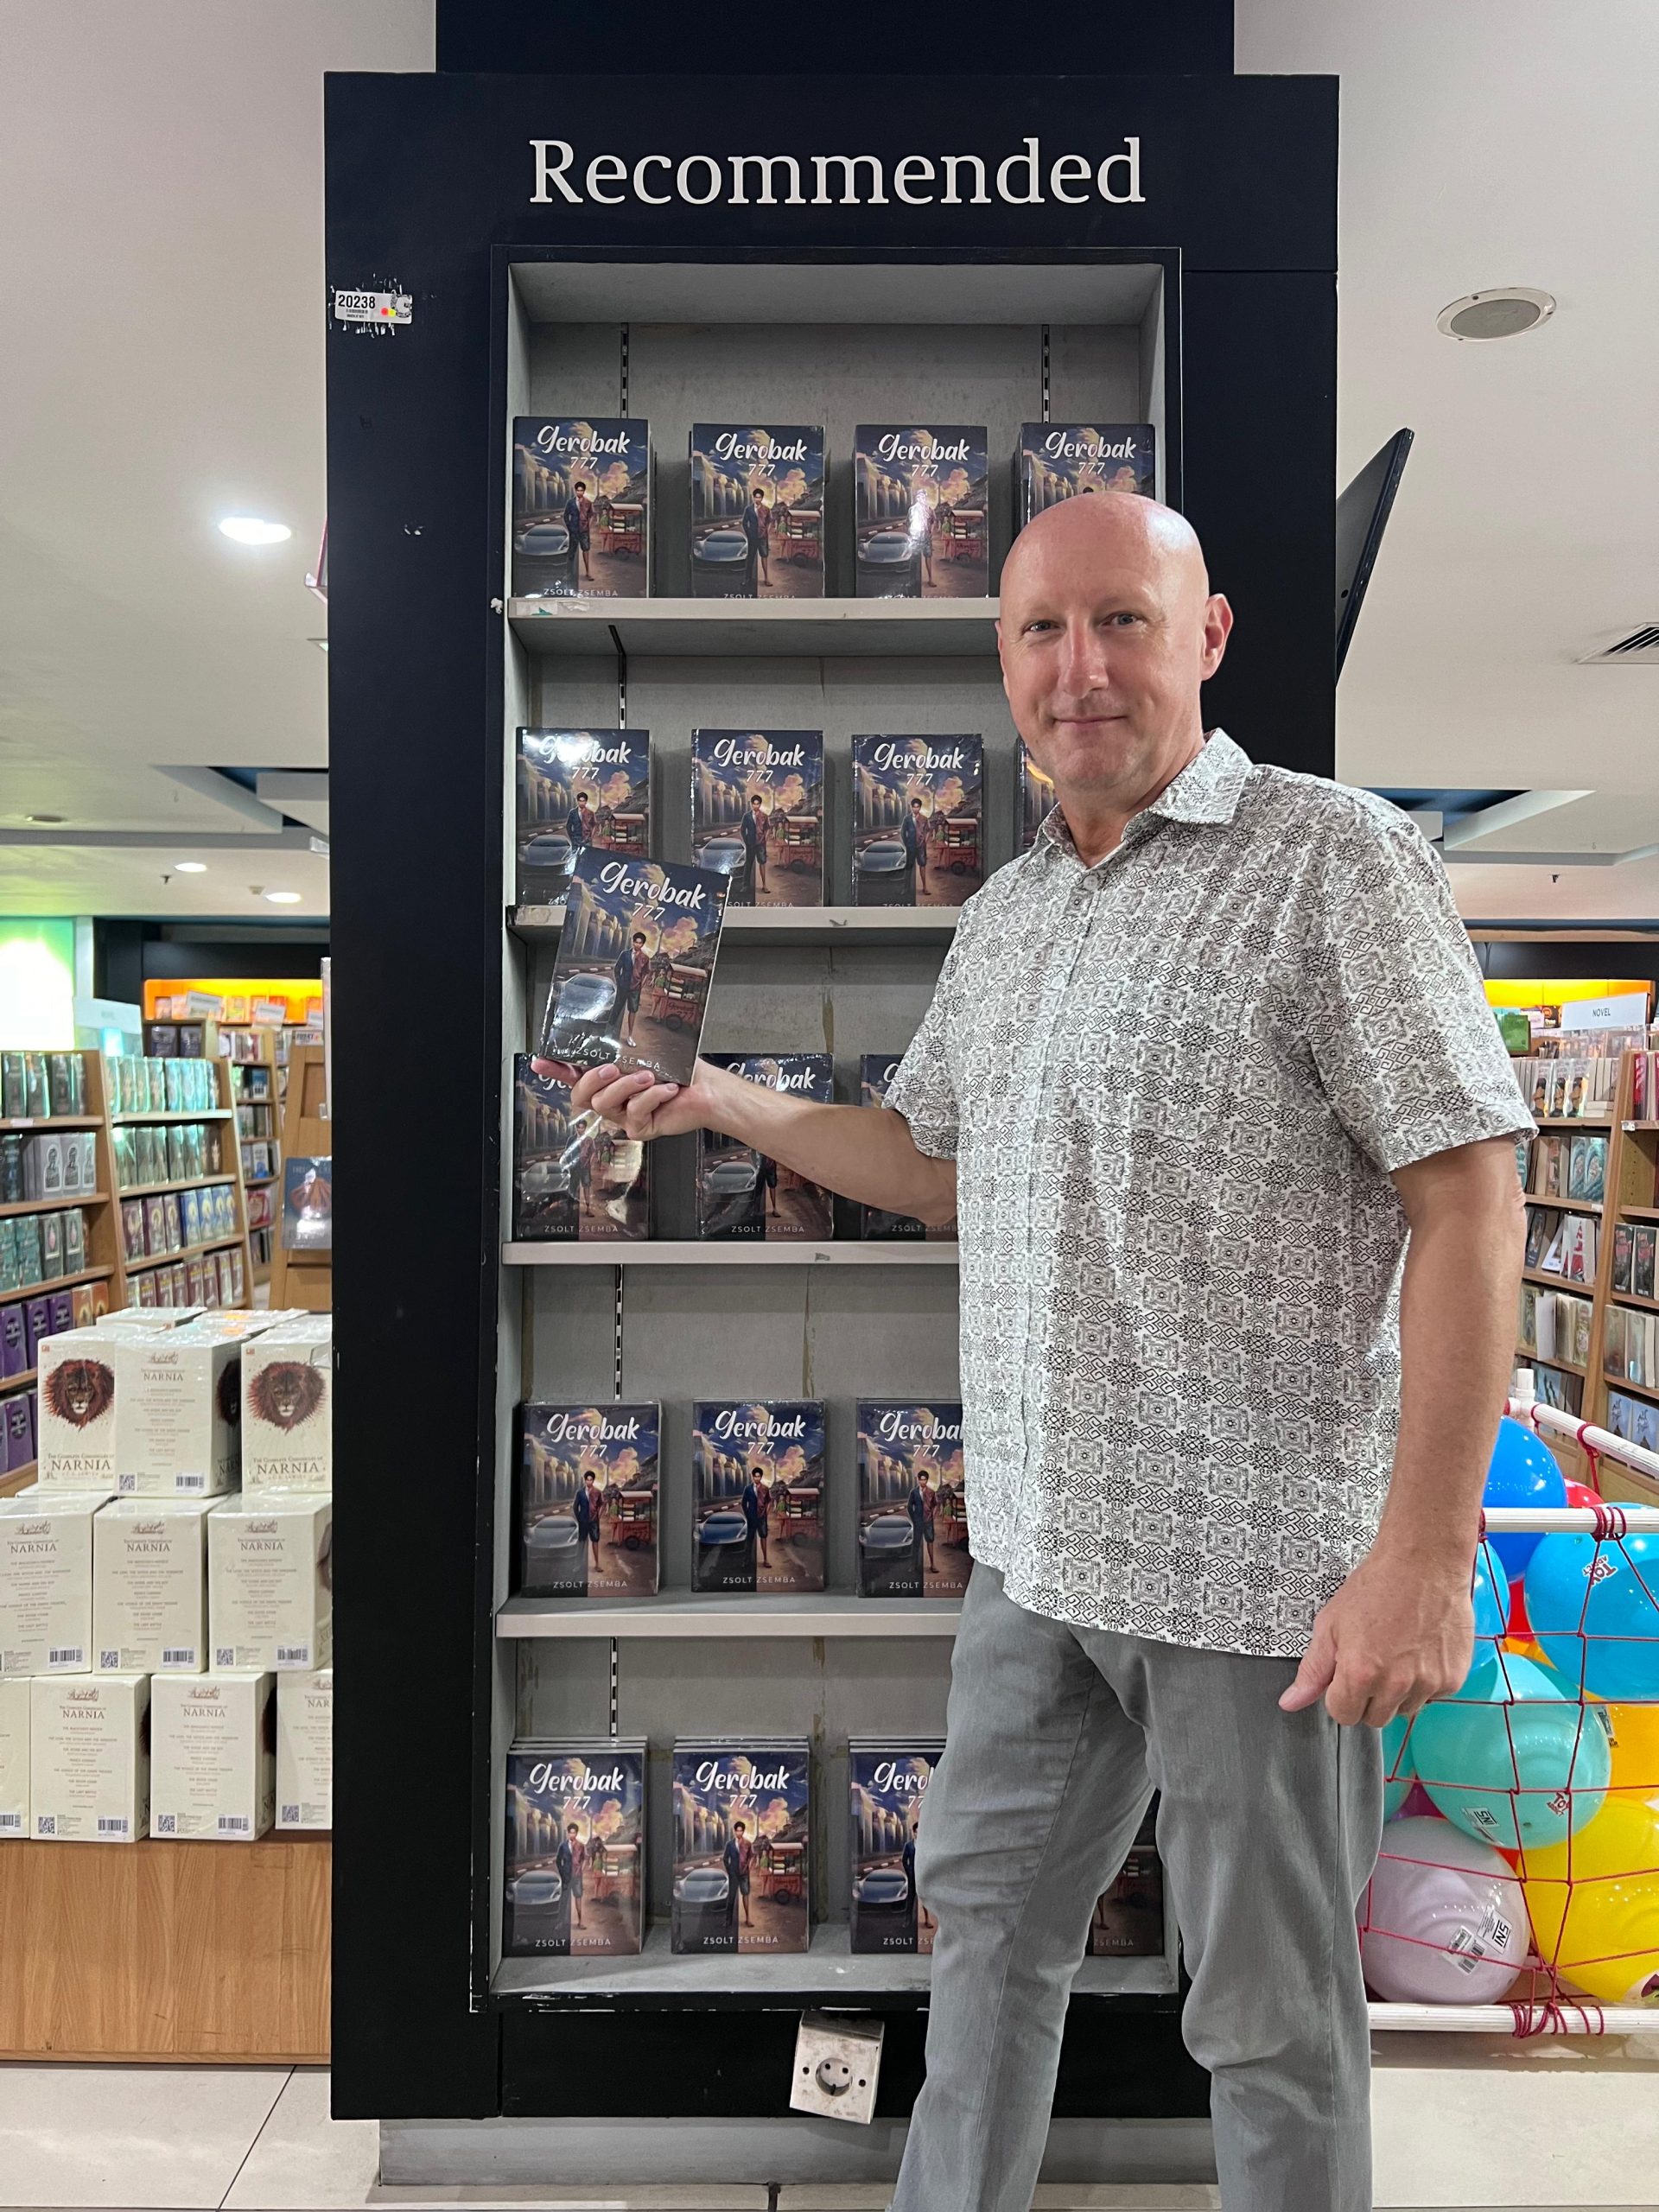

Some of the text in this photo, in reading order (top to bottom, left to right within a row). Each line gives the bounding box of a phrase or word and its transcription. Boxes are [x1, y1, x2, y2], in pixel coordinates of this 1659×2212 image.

[529, 136, 1147, 206] Recommended
[338, 295, 376, 309] 20238
[537, 426, 631, 454] Gerobak
[1045, 431, 1137, 461] Gerobak
[715, 433, 808, 462] Gerobak
[878, 434, 970, 462] Gerobak
[570, 457, 598, 470] 777
[1078, 462, 1105, 475] 777
[748, 464, 776, 477] 777
[911, 464, 939, 478] 777
[714, 739, 805, 767] Gerobak
[874, 743, 964, 772] Gerobak
[571, 767, 600, 780] 777
[746, 771, 774, 783] 777
[906, 774, 934, 786] 777
[600, 861, 707, 911] Gerobak
[632, 902, 666, 922] 777
[1592, 1007, 1611, 1017] NOVEL
[143, 1372, 184, 1382] NARNIA
[546, 1413, 640, 1443] Gerobak
[715, 1410, 807, 1440] Gerobak
[580, 1445, 607, 1458] 777
[747, 1441, 775, 1455] 777
[912, 1444, 940, 1458] 777
[52, 1459, 111, 1471] NARNIA
[257, 1462, 319, 1475] NARNIA
[10, 1542, 57, 1554] NARNIA
[126, 1542, 171, 1553] NARNIA
[240, 1541, 284, 1552] NARNIA
[308, 1699, 330, 1708] NAR
[62, 1710, 105, 1719] NARNIA
[183, 1707, 226, 1718] NARNIA
[529, 1763, 625, 1794] Gerobak
[695, 1761, 791, 1792] Gerobak
[874, 1761, 931, 1793] Gero
[563, 1796, 591, 1810] 777
[729, 1794, 758, 1808] 777
[907, 1796, 924, 1809] 77
[703, 1936, 734, 1945] ZSOLT
[882, 1937, 914, 1946] ZSOLT
[1494, 1922, 1510, 1948] SNI
[535, 1938, 611, 1948] ZSOLT ZSEMBA
